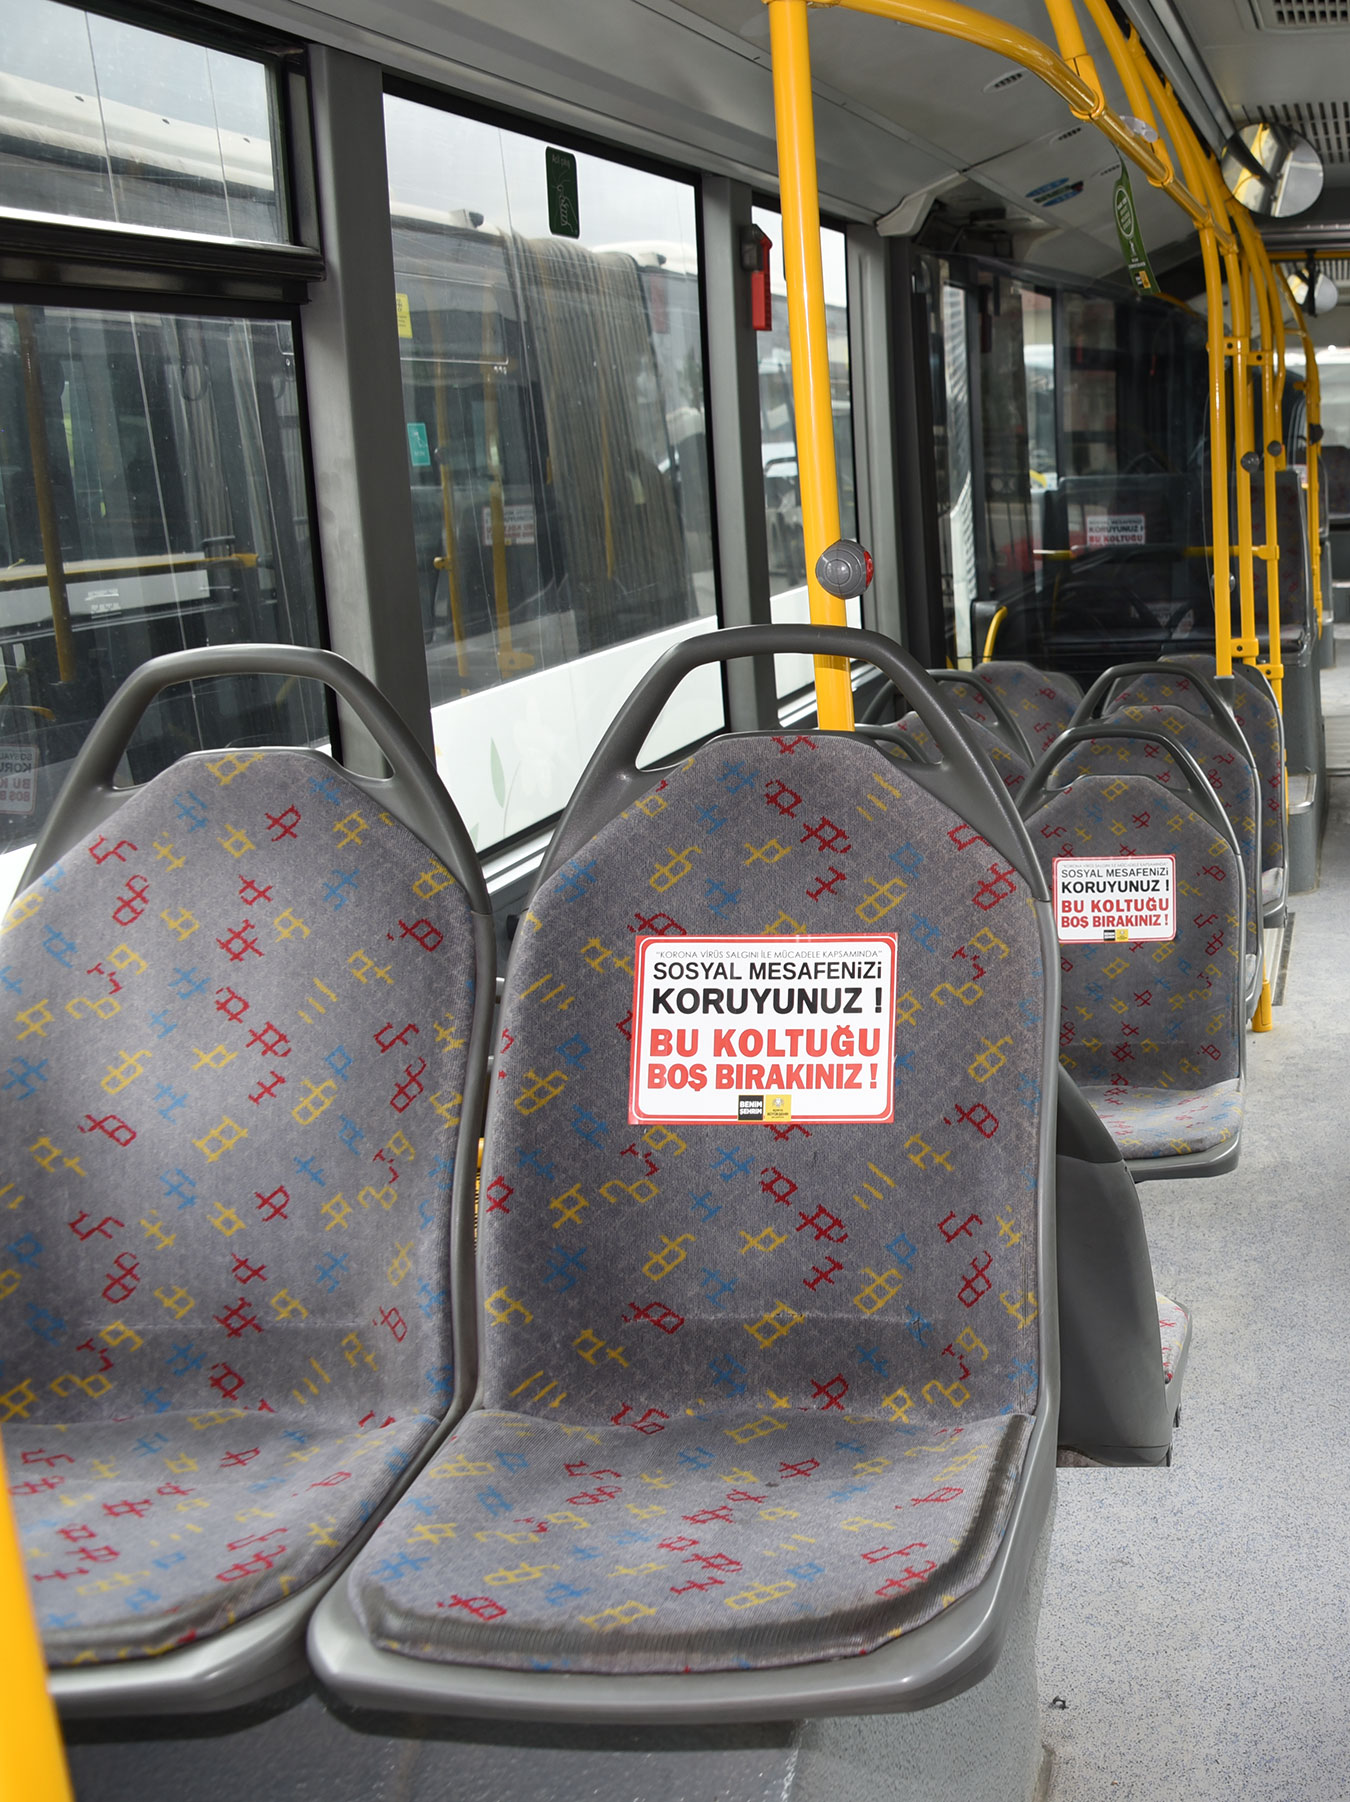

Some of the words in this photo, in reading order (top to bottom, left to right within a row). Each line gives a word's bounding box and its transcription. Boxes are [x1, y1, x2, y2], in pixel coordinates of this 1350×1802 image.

[1061, 869, 1103, 878] SOSYAL
[1061, 880, 1160, 893] KORUYUNUZ
[1061, 900, 1084, 913] BU
[1091, 897, 1169, 912] KOLTUĞU
[1061, 916, 1089, 928] BOŞ
[1092, 914, 1161, 927] BIRAKINIZ
[653, 962, 742, 981] SOSYAL
[652, 987, 863, 1014] KORUYUNUZ
[649, 1028, 699, 1058] BU
[713, 1025, 881, 1058] KOLTUĞU
[647, 1064, 708, 1092] BOŞ
[715, 1063, 863, 1090] BIRAKINIZ
